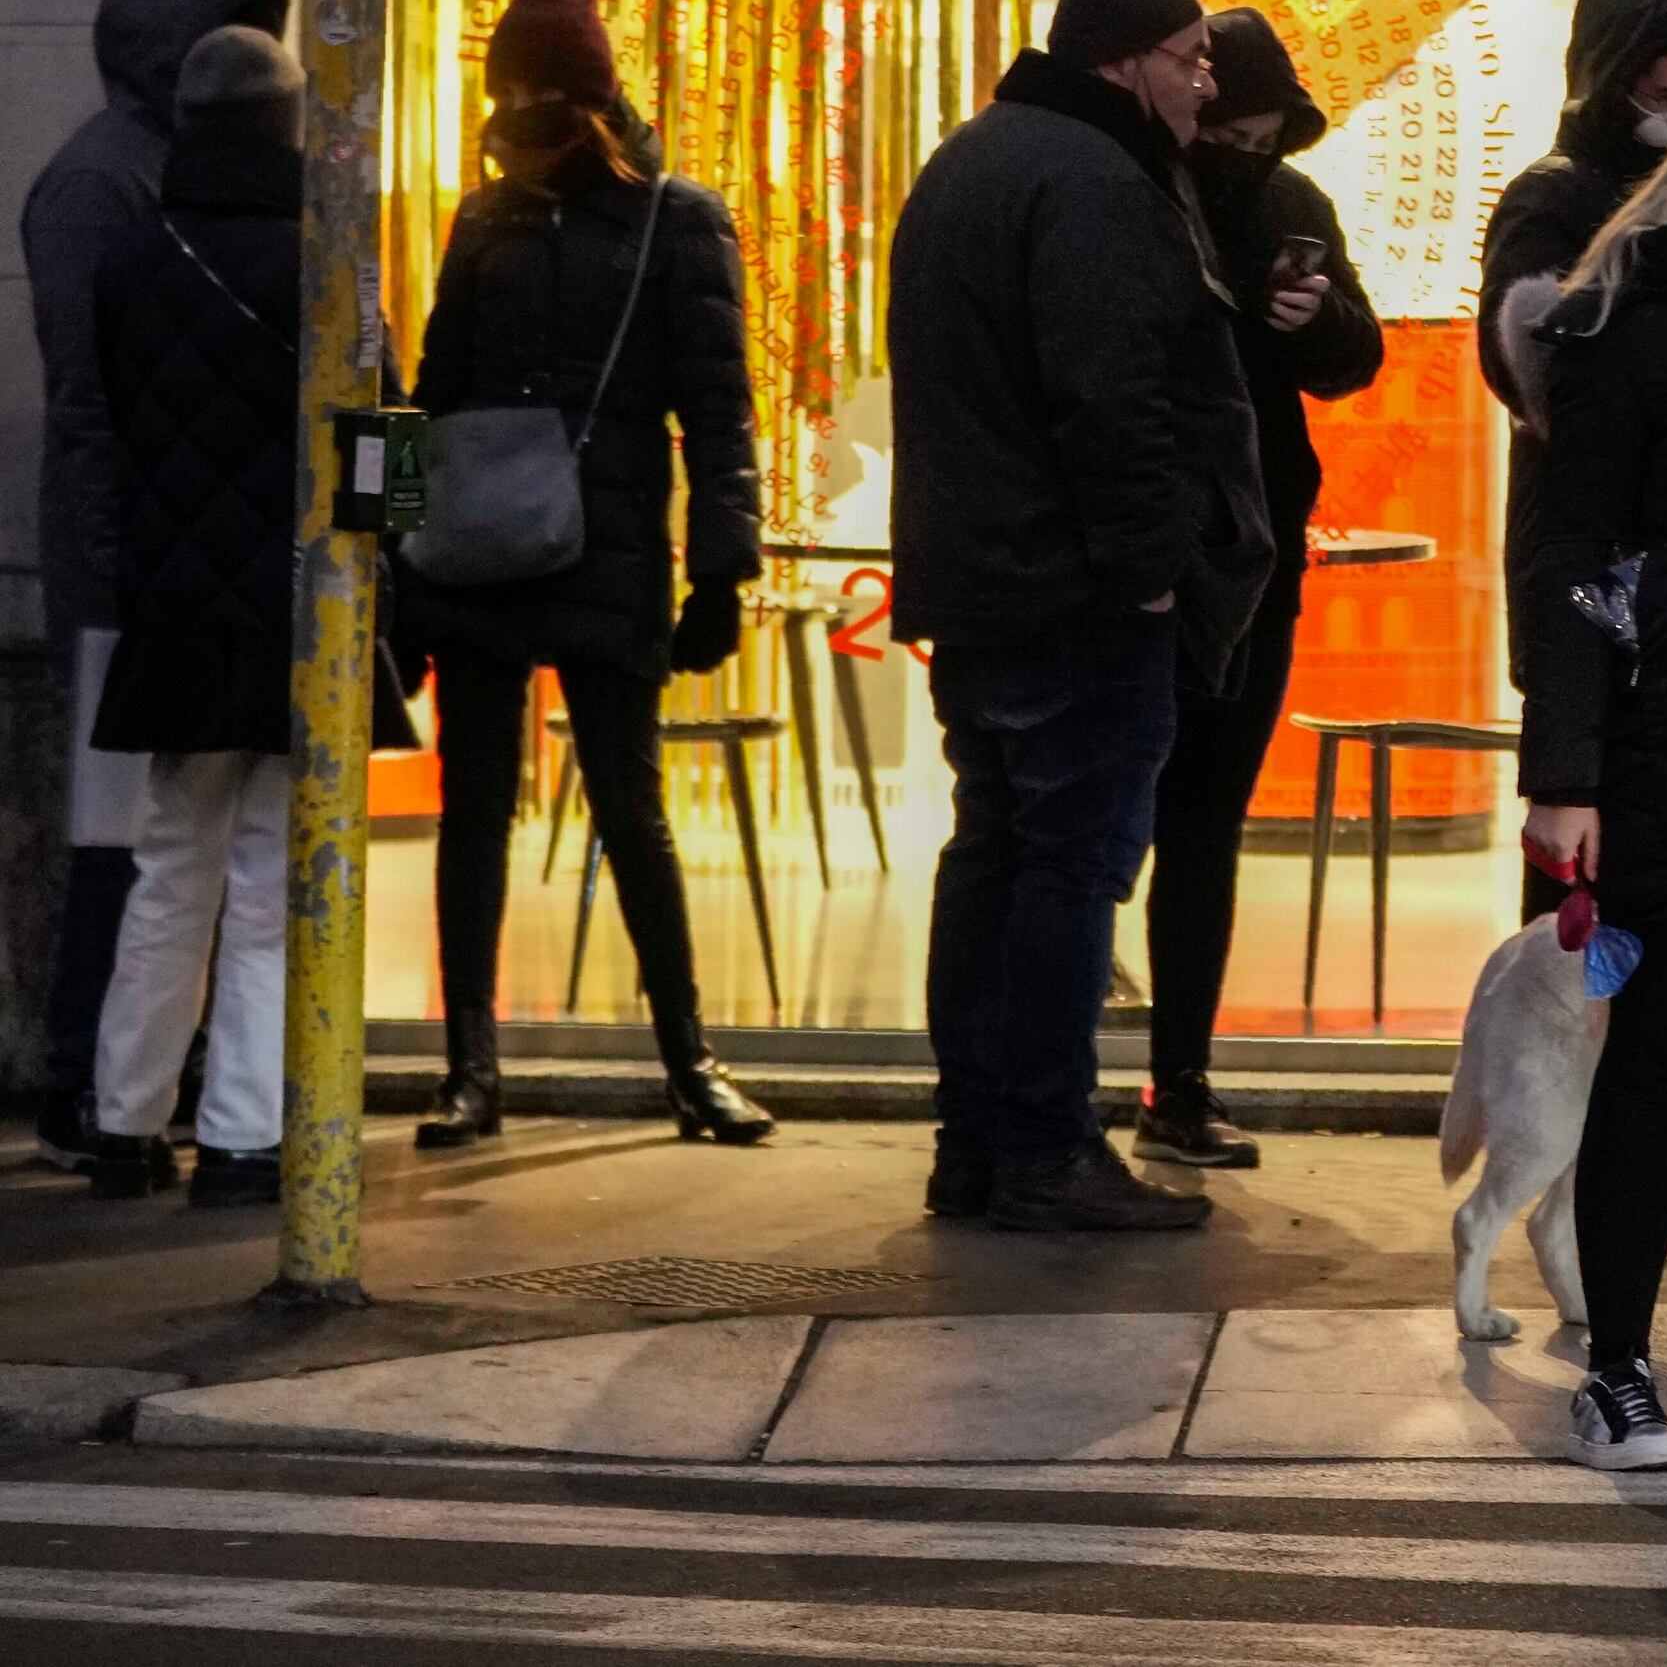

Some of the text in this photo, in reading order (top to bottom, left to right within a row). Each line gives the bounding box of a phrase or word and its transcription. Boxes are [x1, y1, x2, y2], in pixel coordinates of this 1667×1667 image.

[681, 111, 700, 123] 7
[678, 134, 701, 149] 6
[680, 158, 702, 174] 5
